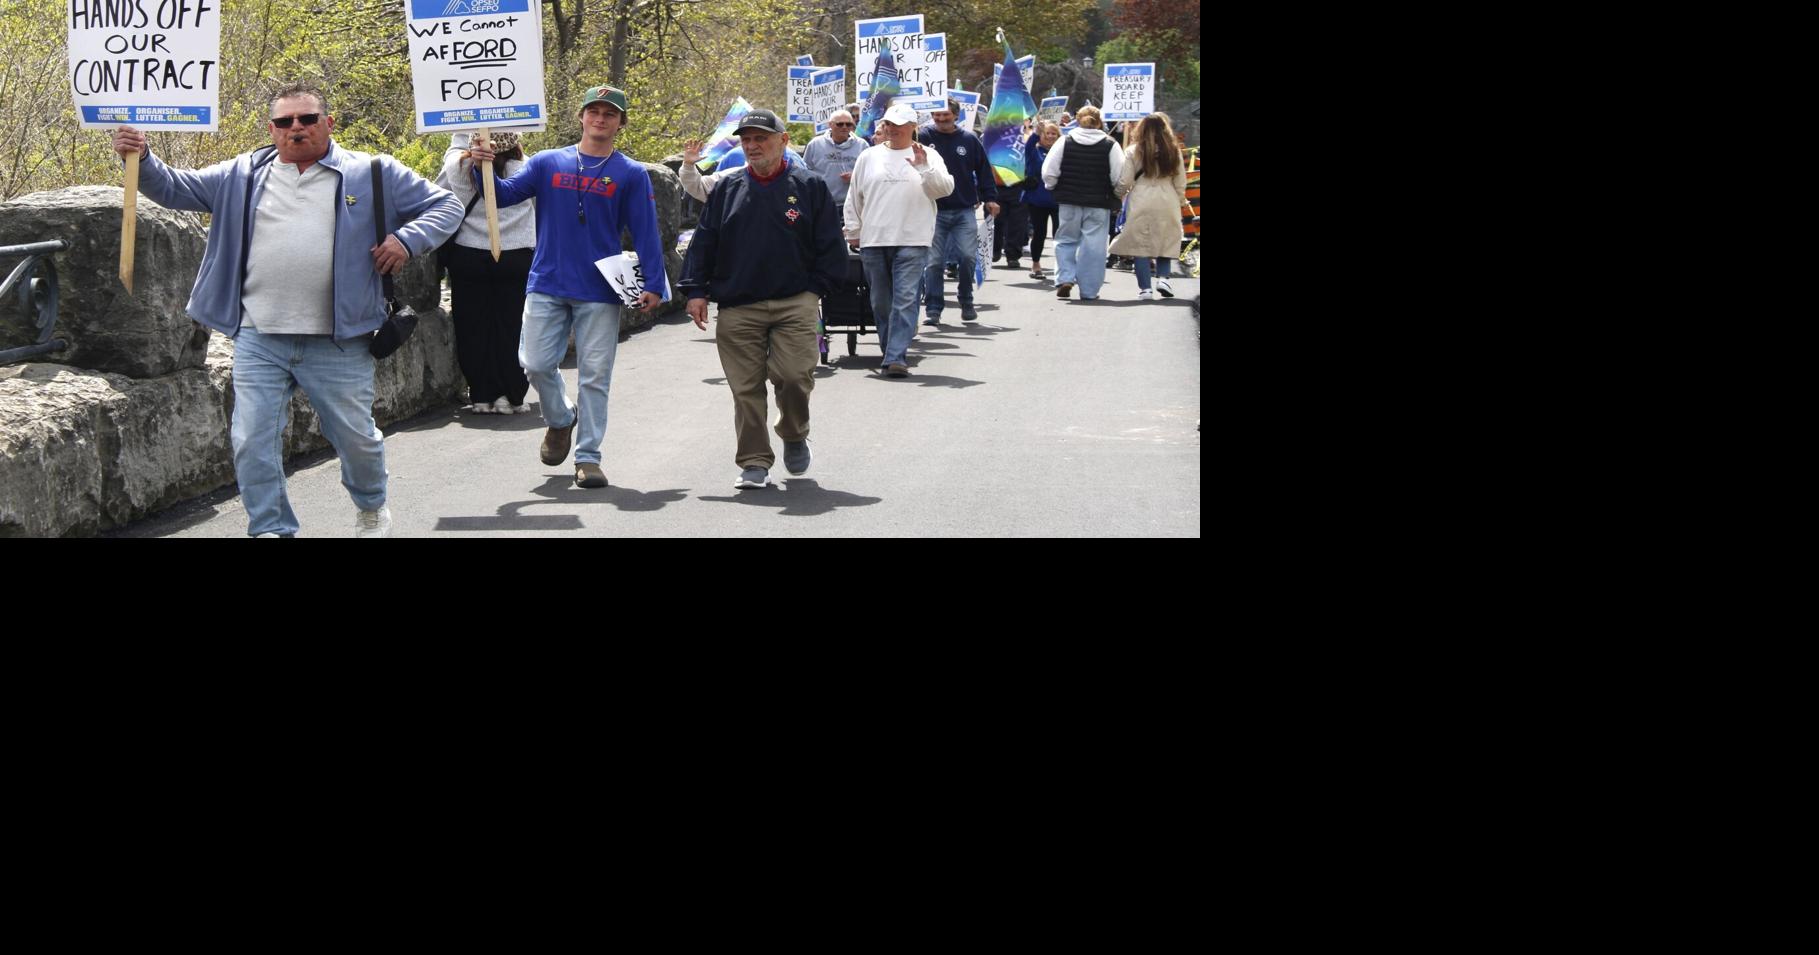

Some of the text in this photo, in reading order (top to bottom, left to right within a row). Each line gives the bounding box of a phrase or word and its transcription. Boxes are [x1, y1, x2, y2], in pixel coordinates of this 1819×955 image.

[72, 0, 212, 30] HANDS OFF
[472, 5, 499, 14] SEFPO
[408, 16, 518, 38] WE Cannot
[104, 34, 171, 55] OUR
[422, 38, 517, 62] AFFORD
[902, 33, 923, 50] OFF
[926, 50, 946, 63] OFF
[73, 58, 216, 96] CONTRACT
[441, 78, 516, 102] FORD
[814, 81, 844, 98] HANDS OFF
[1113, 91, 1144, 100] KEEP
[821, 96, 836, 107] OUR
[1113, 101, 1142, 111] OUT
[136, 107, 182, 115] ORGANISER.
[136, 114, 200, 122] LUTTER. GAGNER.
